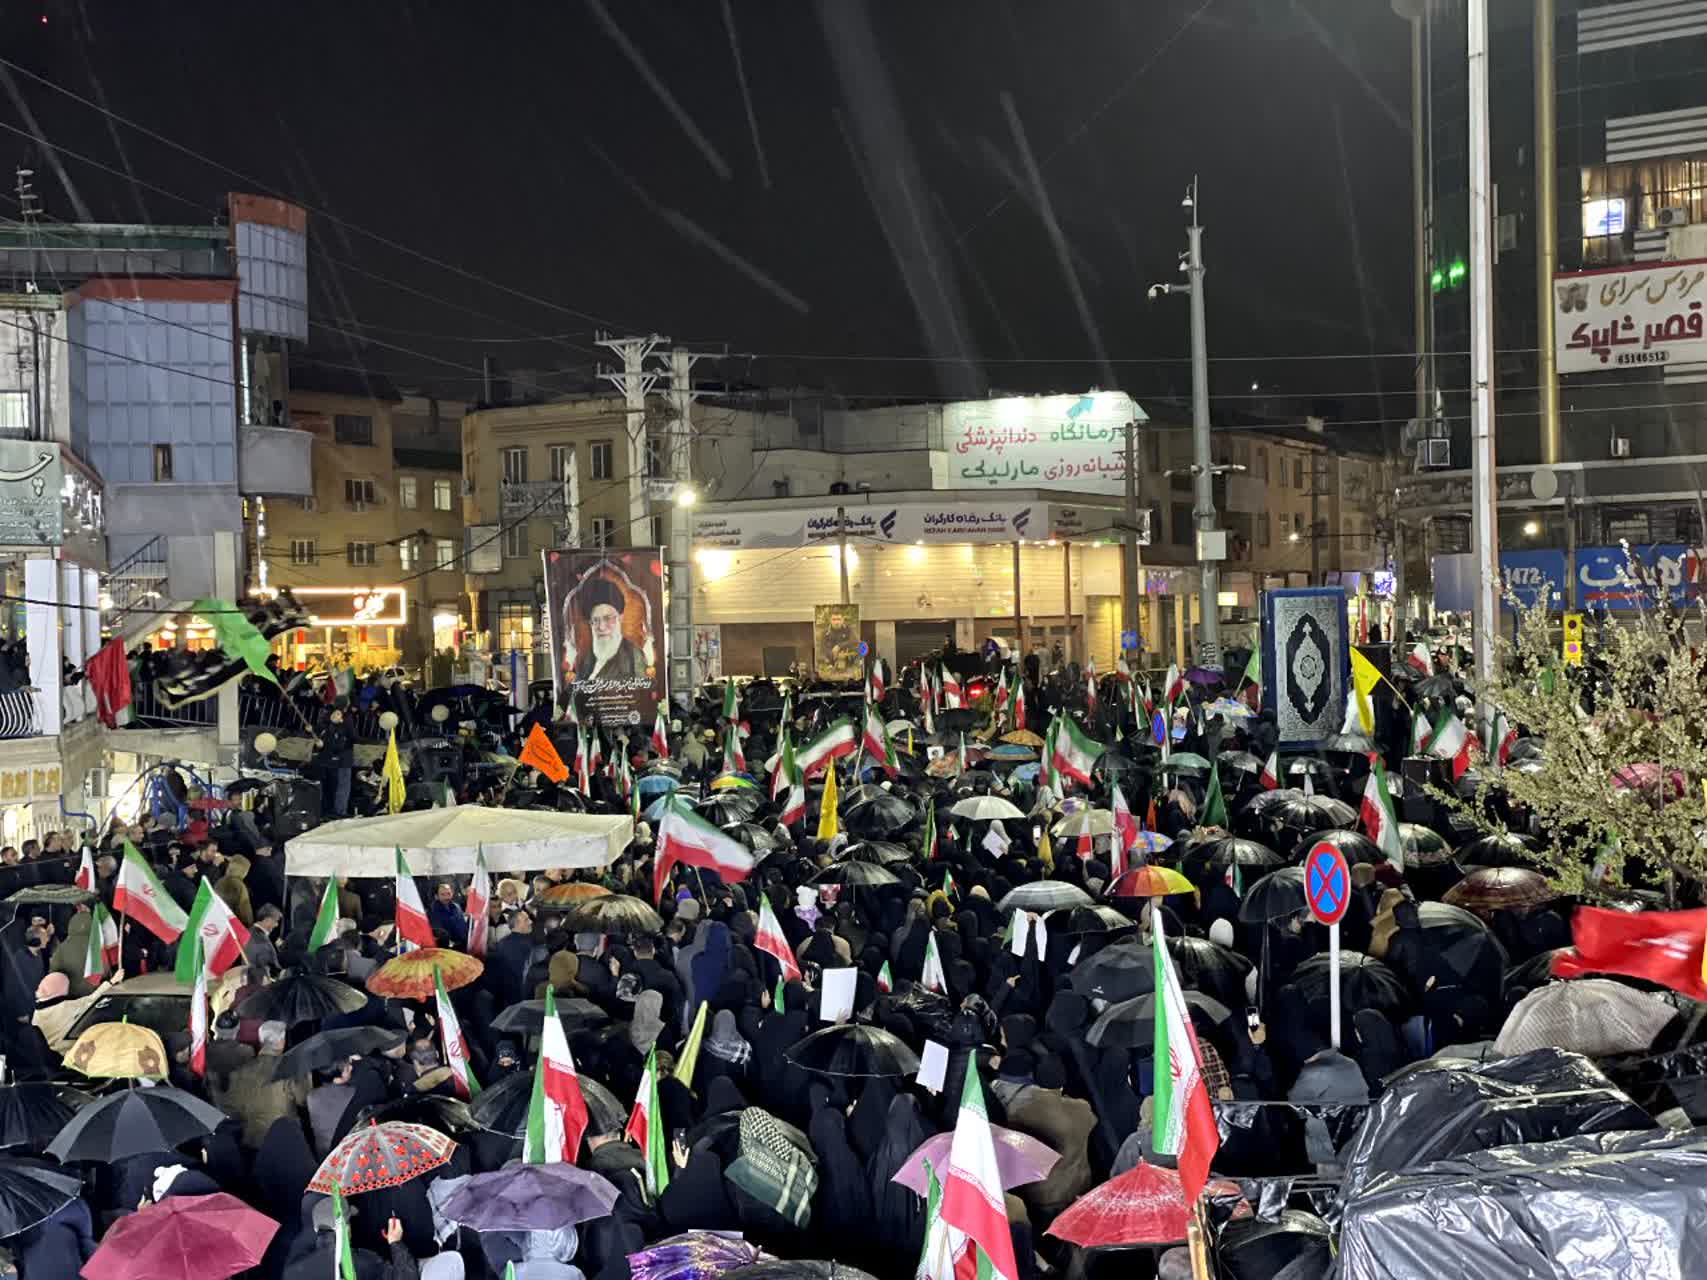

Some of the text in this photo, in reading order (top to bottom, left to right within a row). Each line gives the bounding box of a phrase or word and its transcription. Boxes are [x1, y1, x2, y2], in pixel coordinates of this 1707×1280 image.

[1600, 276, 1650, 306] سرای
[1566, 301, 1703, 364] قصر شاپرک
[956, 426, 1038, 454] دندانپزشکی
[961, 460, 1040, 485] مارلیک
[923, 512, 955, 526] کارگران
[981, 511, 1008, 525] بانک
[1503, 567, 1541, 585] 1472
